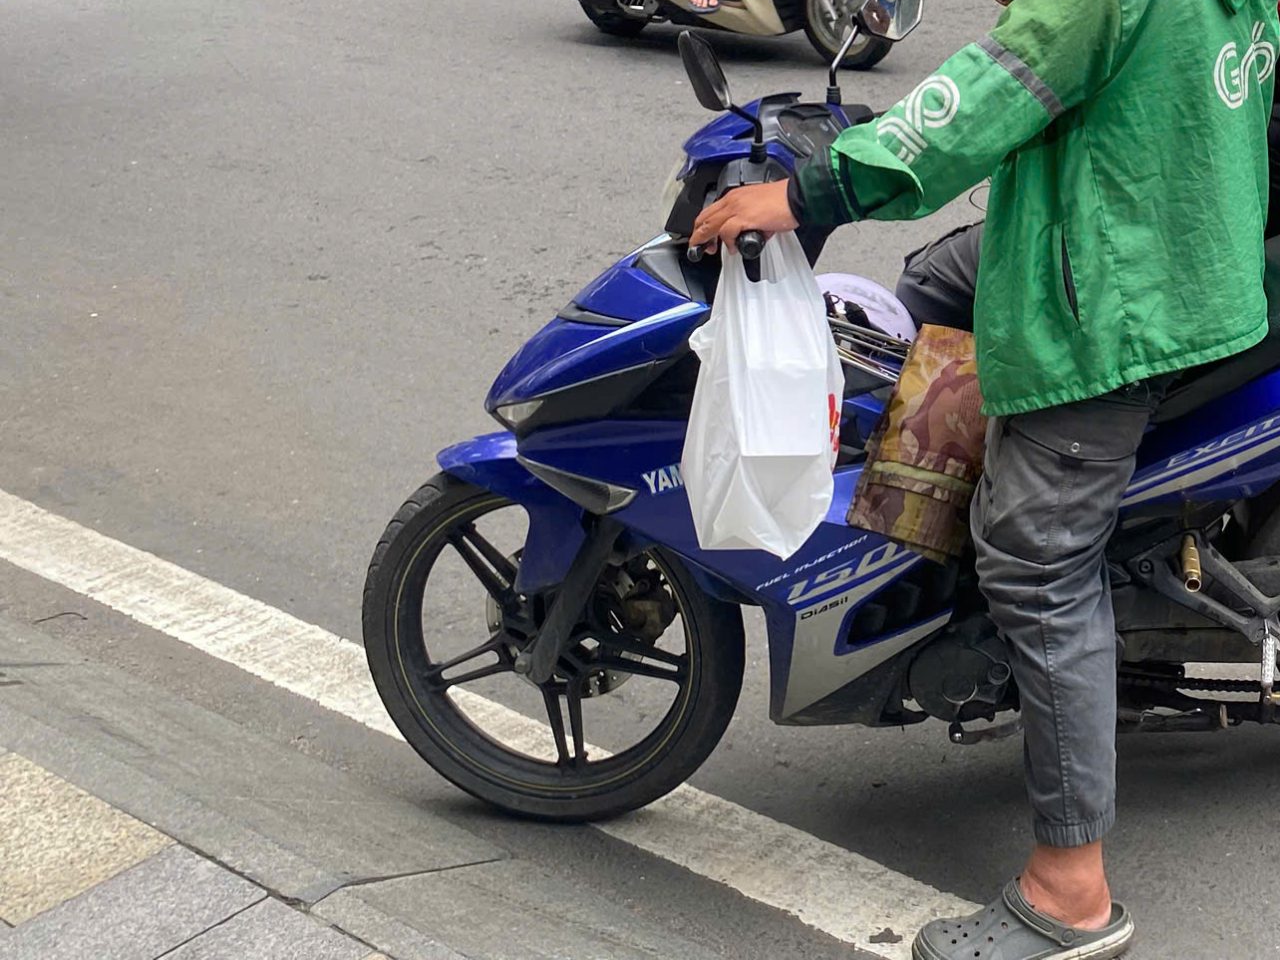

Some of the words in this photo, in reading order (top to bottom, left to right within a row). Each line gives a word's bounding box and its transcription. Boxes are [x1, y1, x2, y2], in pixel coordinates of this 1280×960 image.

[641, 463, 684, 494] YAM
[756, 573, 791, 592] FUEL
[794, 534, 869, 574] INJECTION
[788, 541, 900, 602] 150
